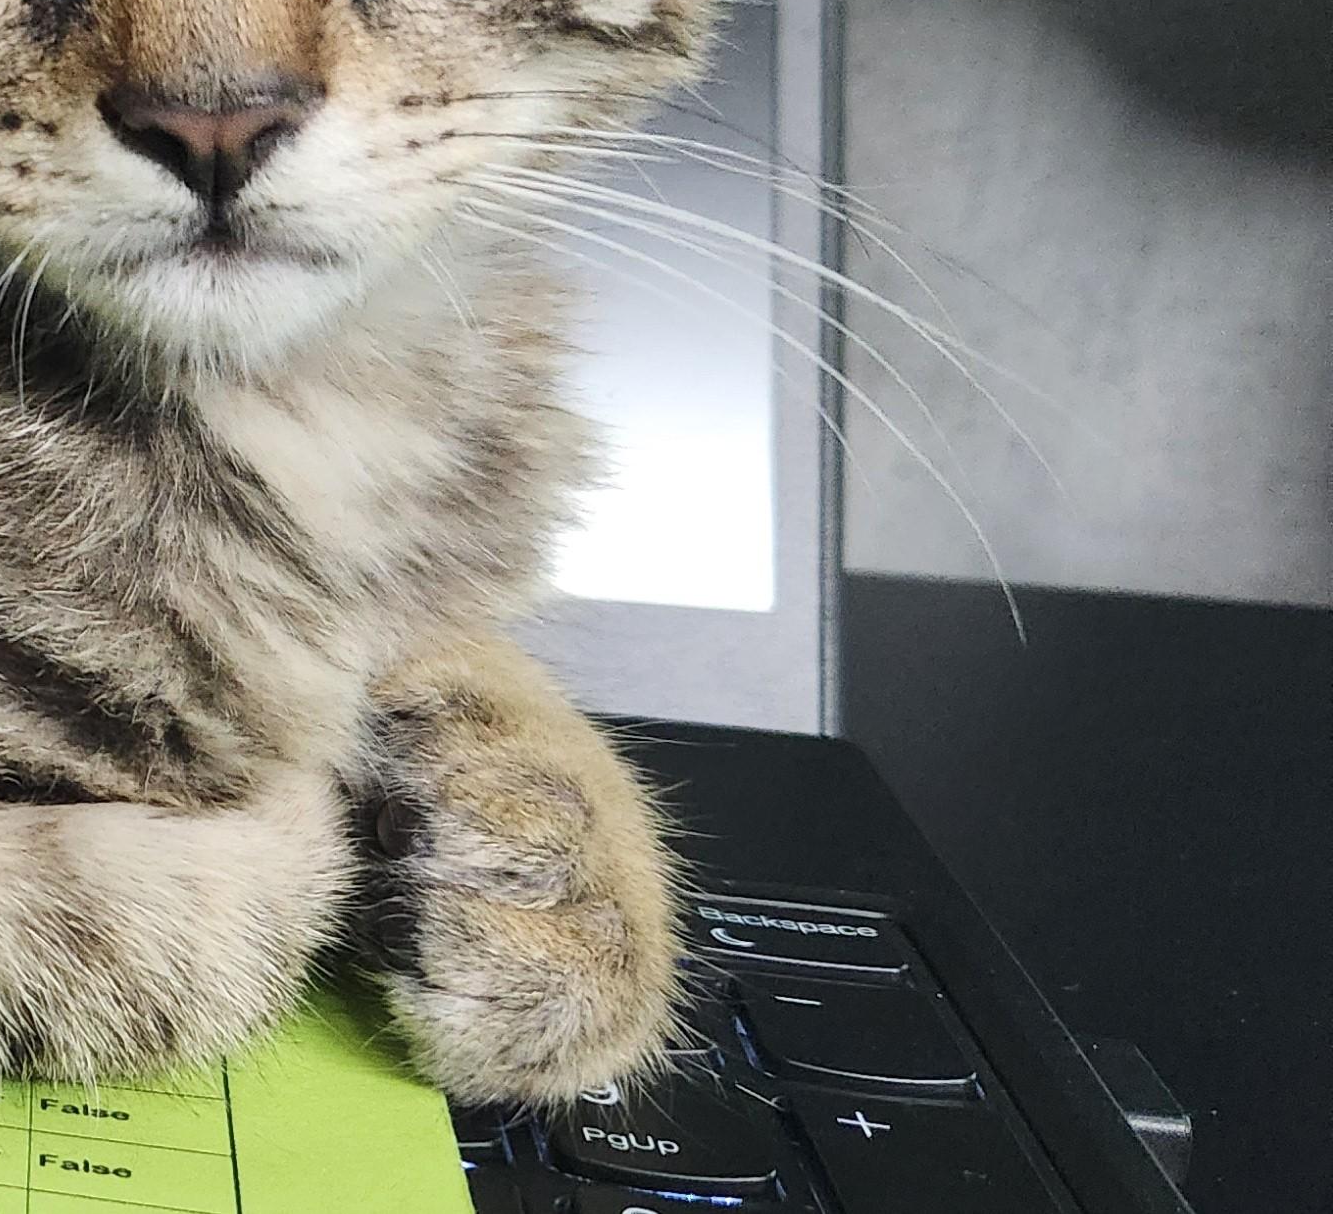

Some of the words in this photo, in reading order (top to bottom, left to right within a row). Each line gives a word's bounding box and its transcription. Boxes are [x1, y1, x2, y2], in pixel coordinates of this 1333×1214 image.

[696, 905, 880, 938] Backspace
[38, 1097, 132, 1123] False
[582, 1125, 682, 1157] PgUp
[37, 1152, 134, 1180] False
